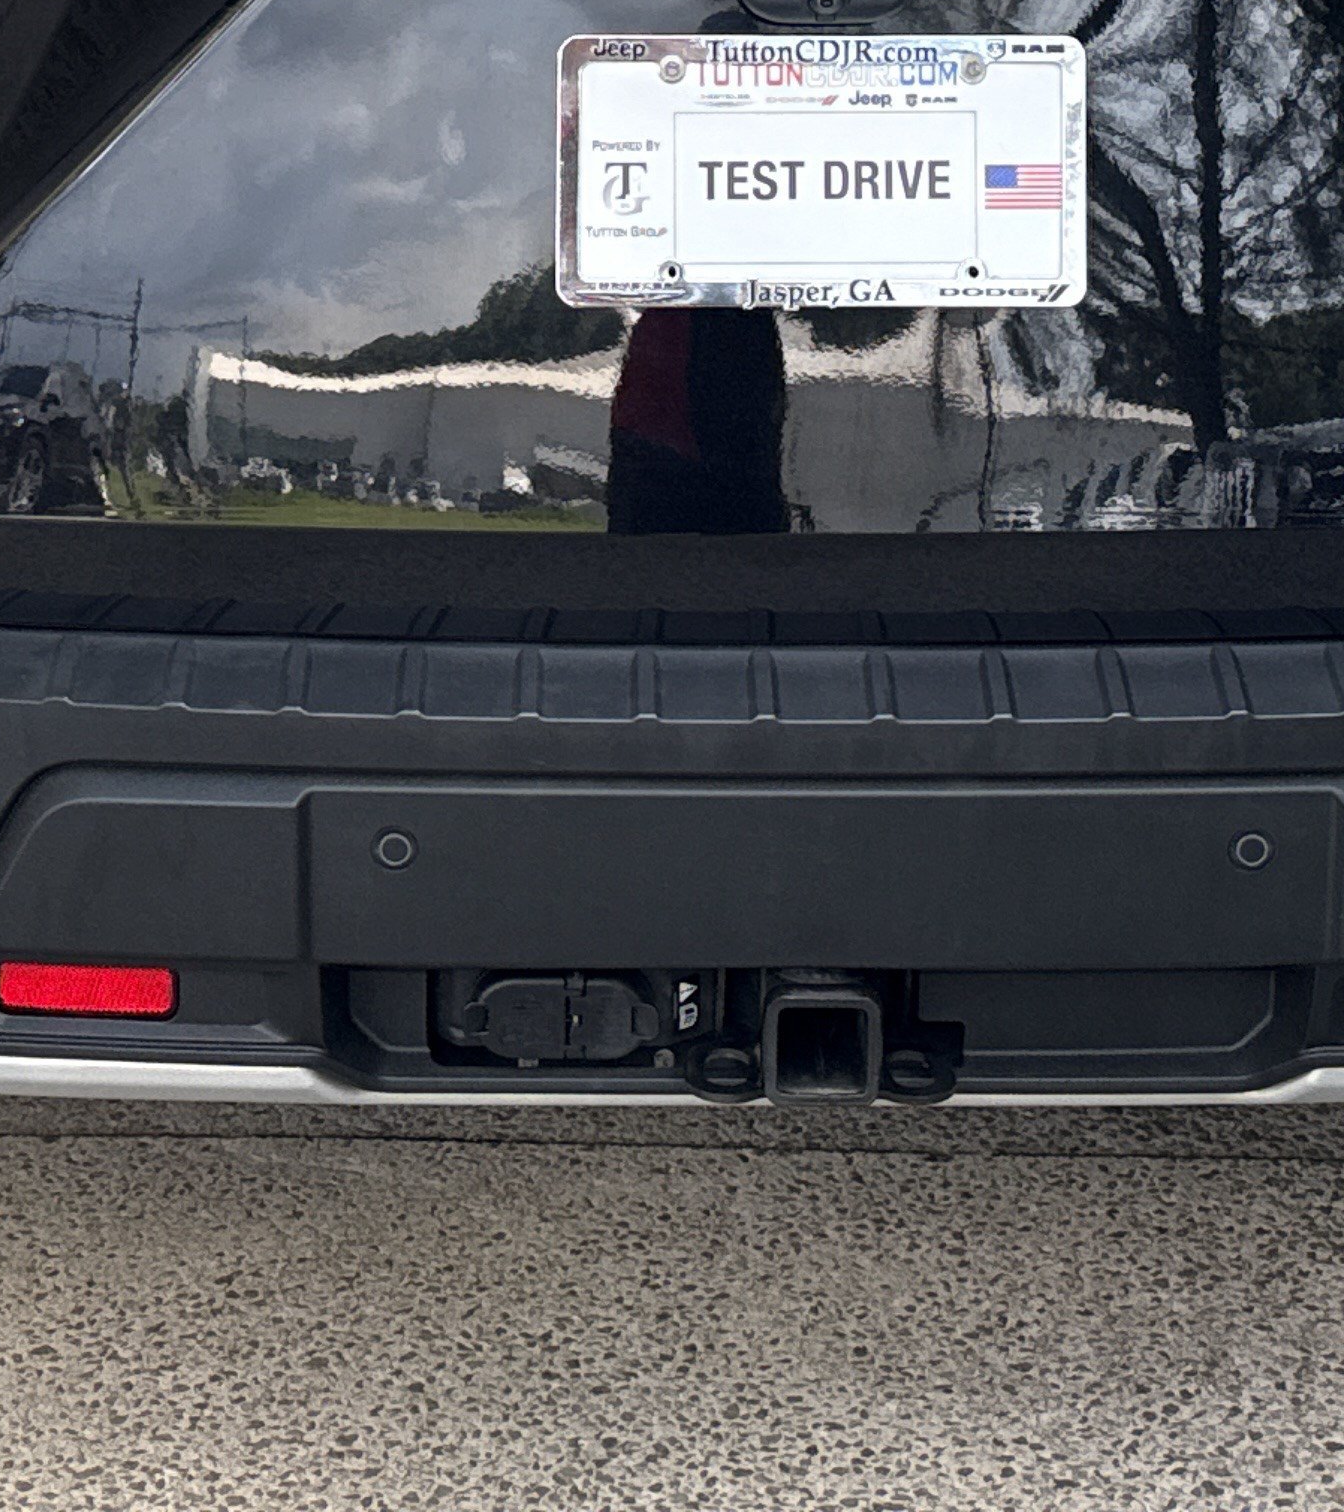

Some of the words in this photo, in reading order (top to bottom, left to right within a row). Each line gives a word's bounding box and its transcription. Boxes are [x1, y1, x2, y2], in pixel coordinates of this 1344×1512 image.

[593, 39, 646, 61] Jeep
[706, 39, 939, 69] TuttonCDJR.com
[1011, 43, 1065, 54] RAM
[848, 90, 892, 108] Jeep
[698, 160, 805, 200] TEST
[823, 160, 951, 200] DRIVE
[744, 279, 840, 309] Jasper,
[849, 279, 896, 302] GA
